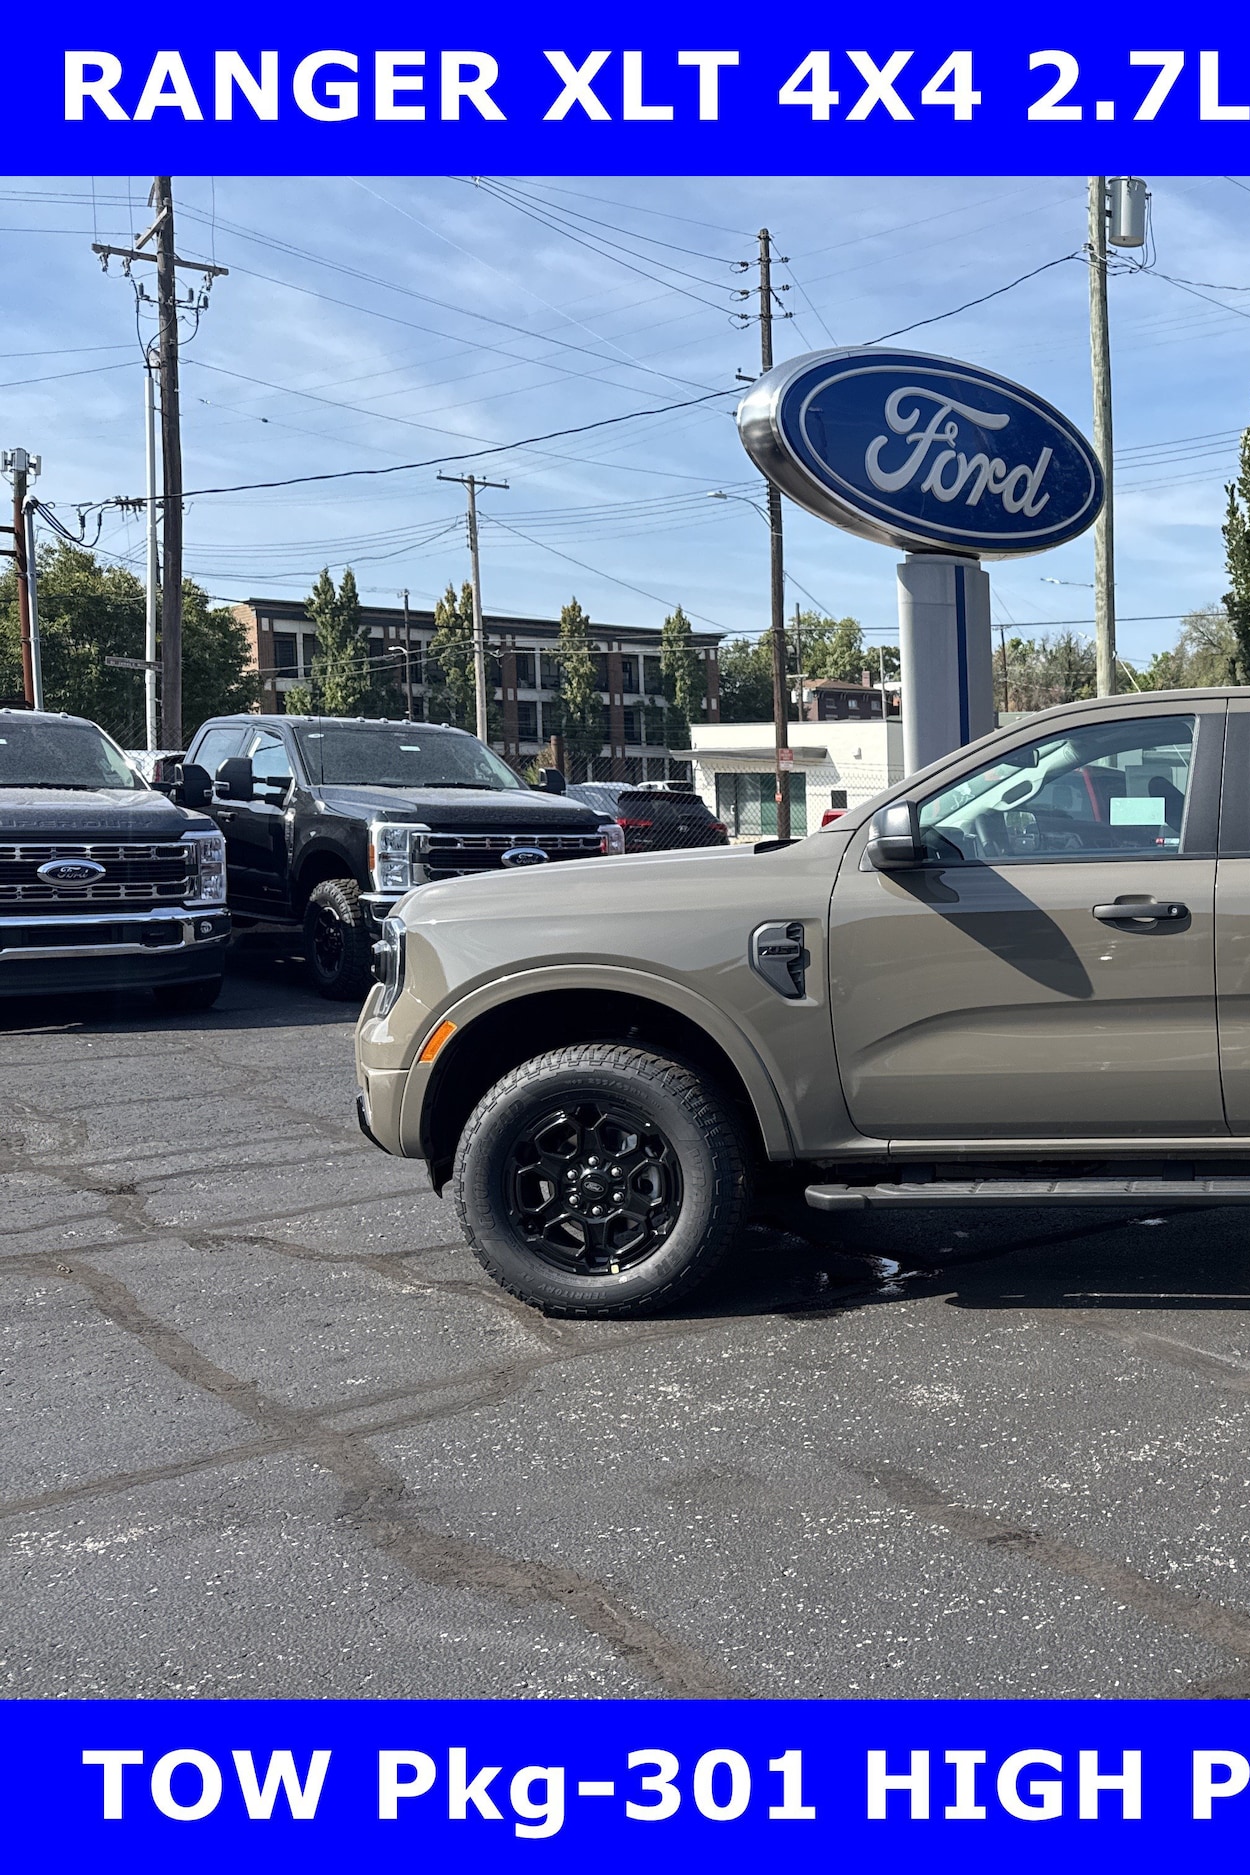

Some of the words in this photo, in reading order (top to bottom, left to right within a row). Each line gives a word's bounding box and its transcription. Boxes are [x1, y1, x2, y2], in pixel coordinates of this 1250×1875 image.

[865, 386, 1054, 518] Ford
[516, 853, 540, 865] Ford
[57, 866, 89, 879] Ford
